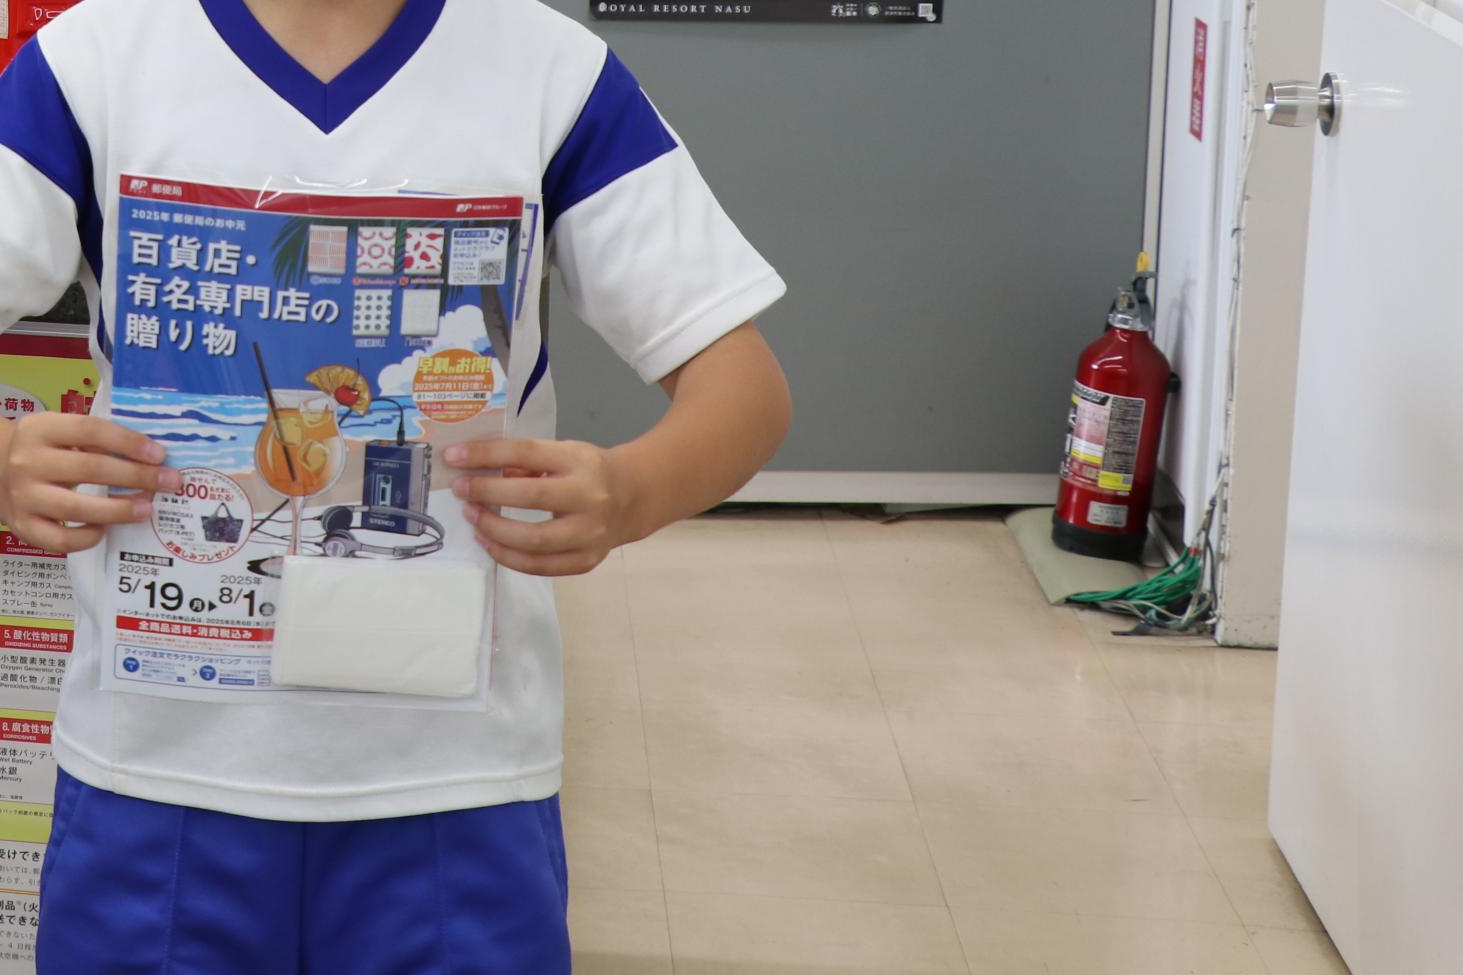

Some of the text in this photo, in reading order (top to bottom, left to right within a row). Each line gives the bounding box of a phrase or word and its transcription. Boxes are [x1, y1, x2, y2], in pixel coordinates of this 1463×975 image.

[653, 4, 707, 13] RESORT
[715, 5, 752, 14] NASU
[152, 183, 182, 196] 郵便局
[131, 208, 247, 231] 2025年 郵便局のお中元
[128, 230, 257, 276] 百貨店・
[127, 272, 340, 324] 有名専門店の
[124, 312, 237, 357] 贈り物
[118, 563, 160, 576] 2025年
[3, 579, 52, 589] キャンプ用ガス
[220, 575, 263, 585] 2025年
[2, 589, 74, 600] カセットコンロ用ガス
[118, 576, 184, 612] 5/19
[219, 586, 256, 617] 8/1
[138, 620, 253, 639] 全商品送料・消費税込み
[1, 655, 66, 667] 小型酸素発生器
[0, 673, 37, 683] 過酸化物
[0, 766, 17, 775] 水銀
